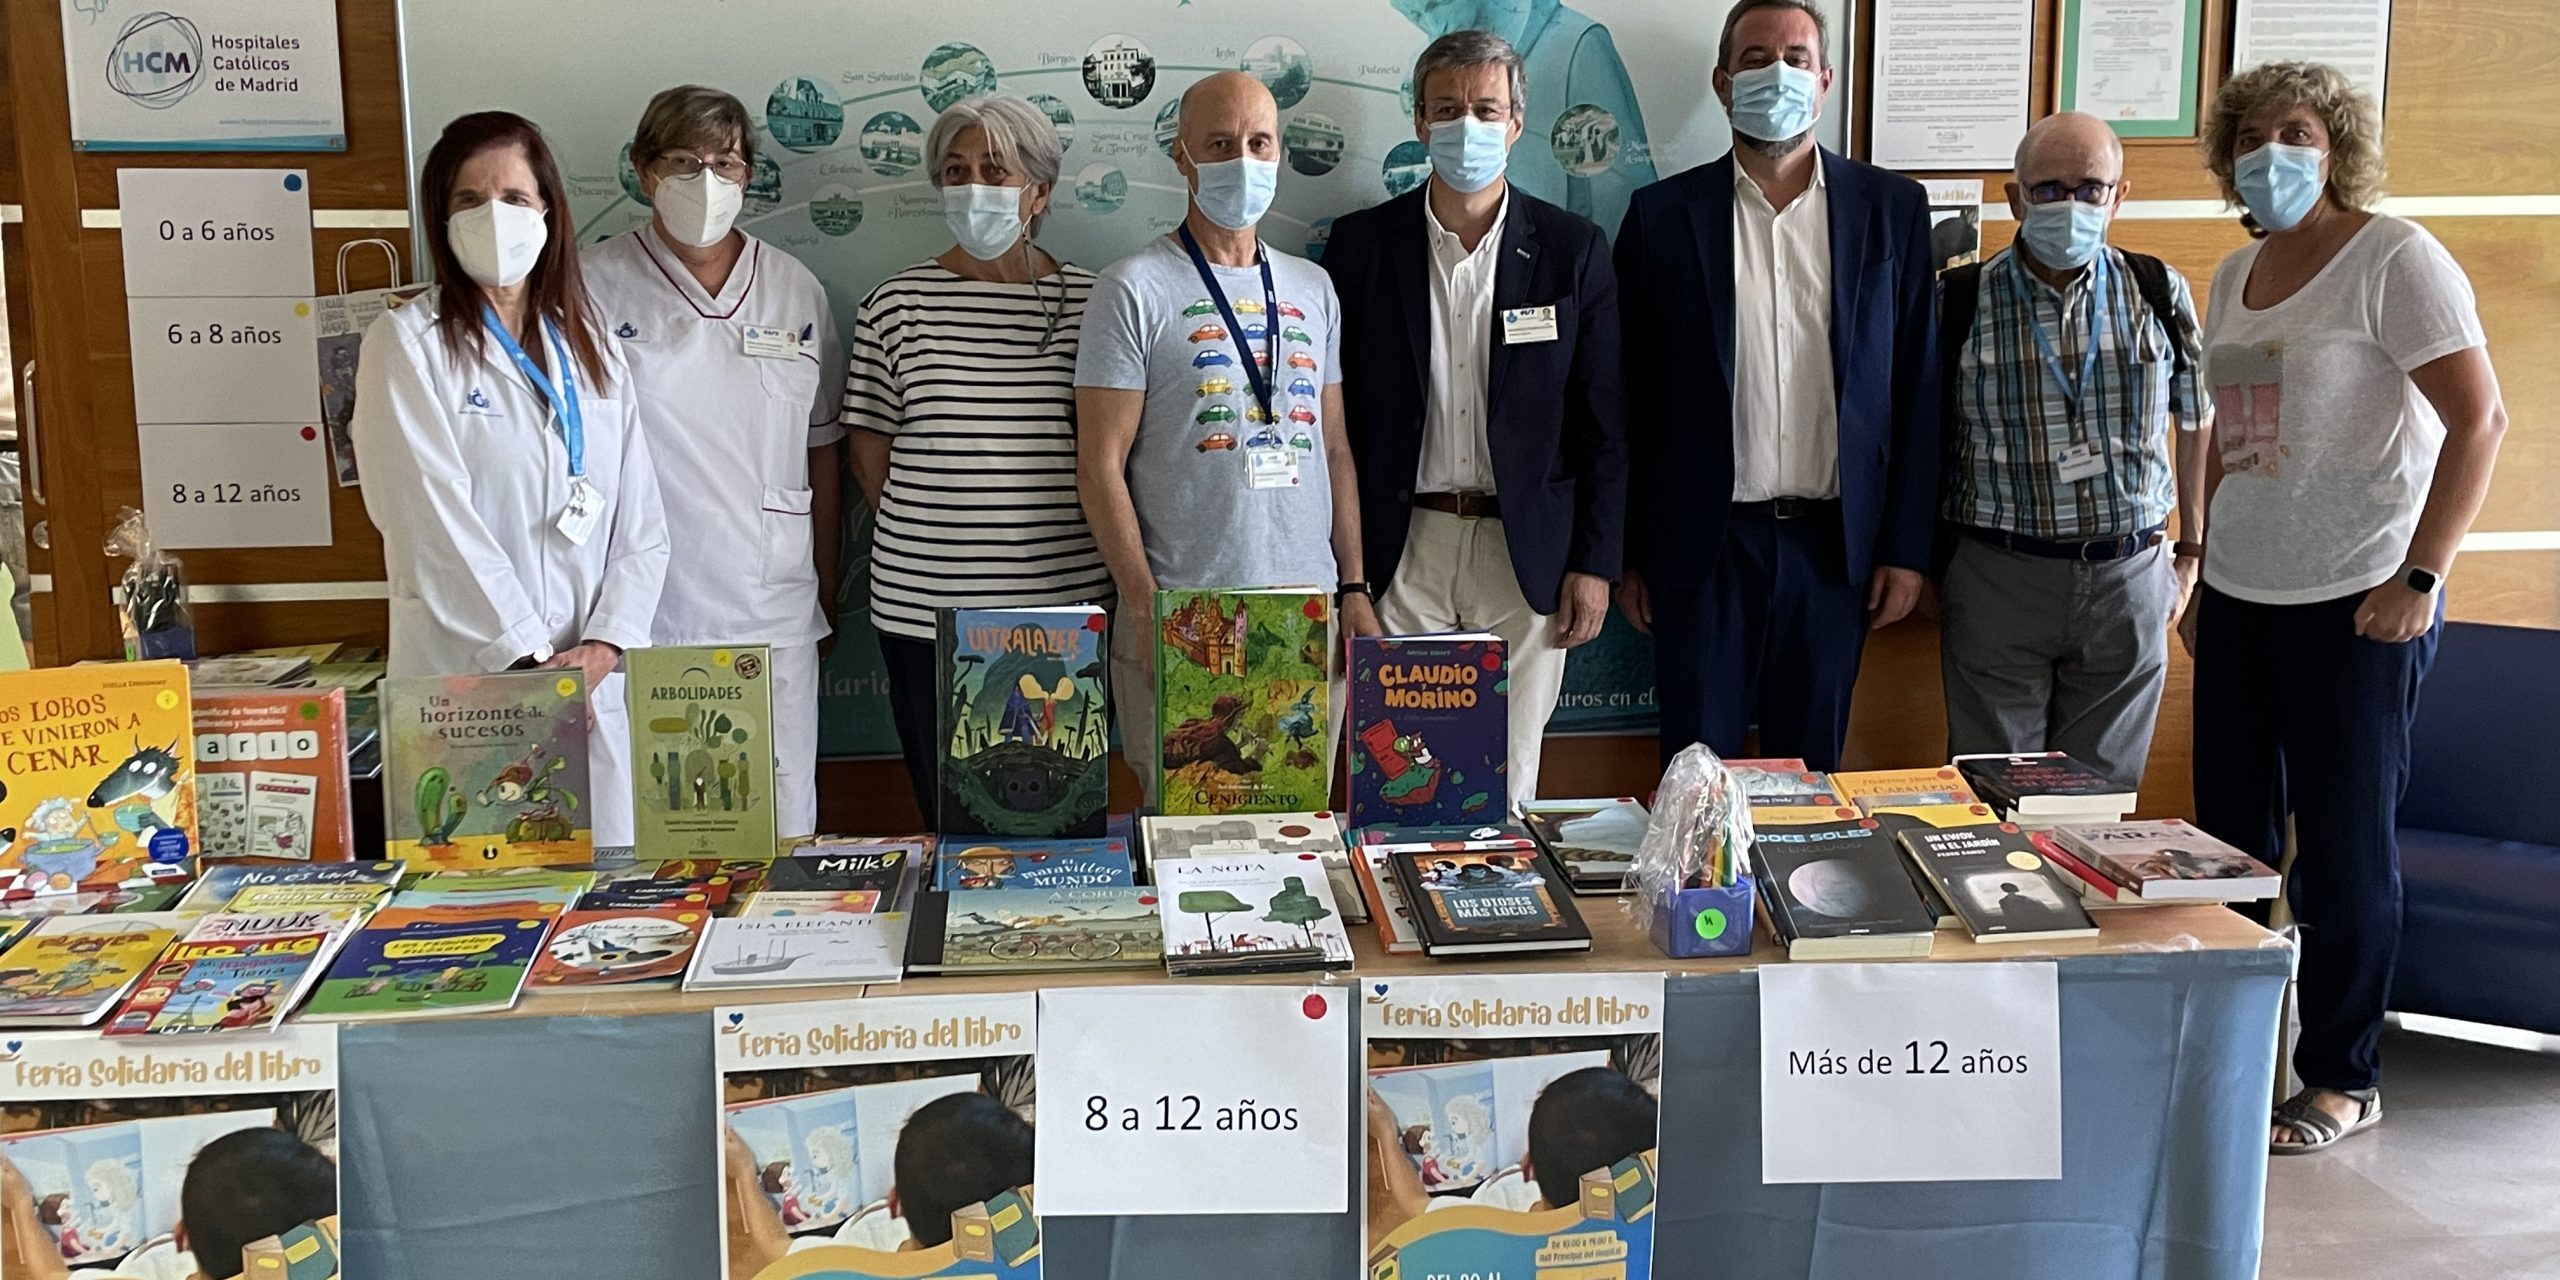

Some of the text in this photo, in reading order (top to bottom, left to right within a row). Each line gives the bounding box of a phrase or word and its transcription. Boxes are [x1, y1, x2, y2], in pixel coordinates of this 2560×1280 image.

[212, 34, 300, 52] Hospitales
[123, 52, 191, 73] HCM
[213, 54, 290, 71] Católicos
[215, 77, 298, 92] de Madrid
[159, 220, 274, 241] 0 a 6 años
[167, 324, 281, 344] 6 a 8 años
[172, 483, 300, 503] 8 a 12 años
[1379, 664, 1478, 687] CLAUDIO
[429, 696, 450, 707] Un
[650, 686, 742, 701] ARBOLIDADES
[1384, 687, 1477, 709] MORINO
[1609, 692, 1630, 706] en
[1638, 686, 1655, 705] el
[30, 694, 106, 722] LOBOS
[420, 704, 545, 723] horizonte de
[22, 717, 120, 745] VINIERON
[127, 713, 141, 730] A
[438, 724, 524, 739] sucesos
[7, 745, 109, 775] CENAR
[1755, 828, 1873, 843] DOCE SOLES
[1924, 832, 1976, 843] UN EWOK
[1930, 838, 2000, 851] EN EL JARDÍN
[818, 855, 897, 871] Milko
[1021, 860, 1123, 879] maravilloso
[1178, 863, 1266, 875] LA NOTA
[1033, 874, 1112, 887] MUNDO
[1452, 898, 1479, 909] LOS
[1493, 905, 1538, 917] LOCOS
[222, 913, 322, 932] NUUK
[737, 920, 778, 931] ISLA
[232, 966, 286, 980] Tierra
[1383, 996, 1649, 1028] Feria Solidaria del libro
[739, 1016, 1021, 1057] Feria Solidaria del libro
[1789, 1040, 2028, 1075] Más de 12 años
[16, 1050, 321, 1087] Feria Solidaria del libro
[1085, 1095, 1298, 1131] 8 a 12 años
